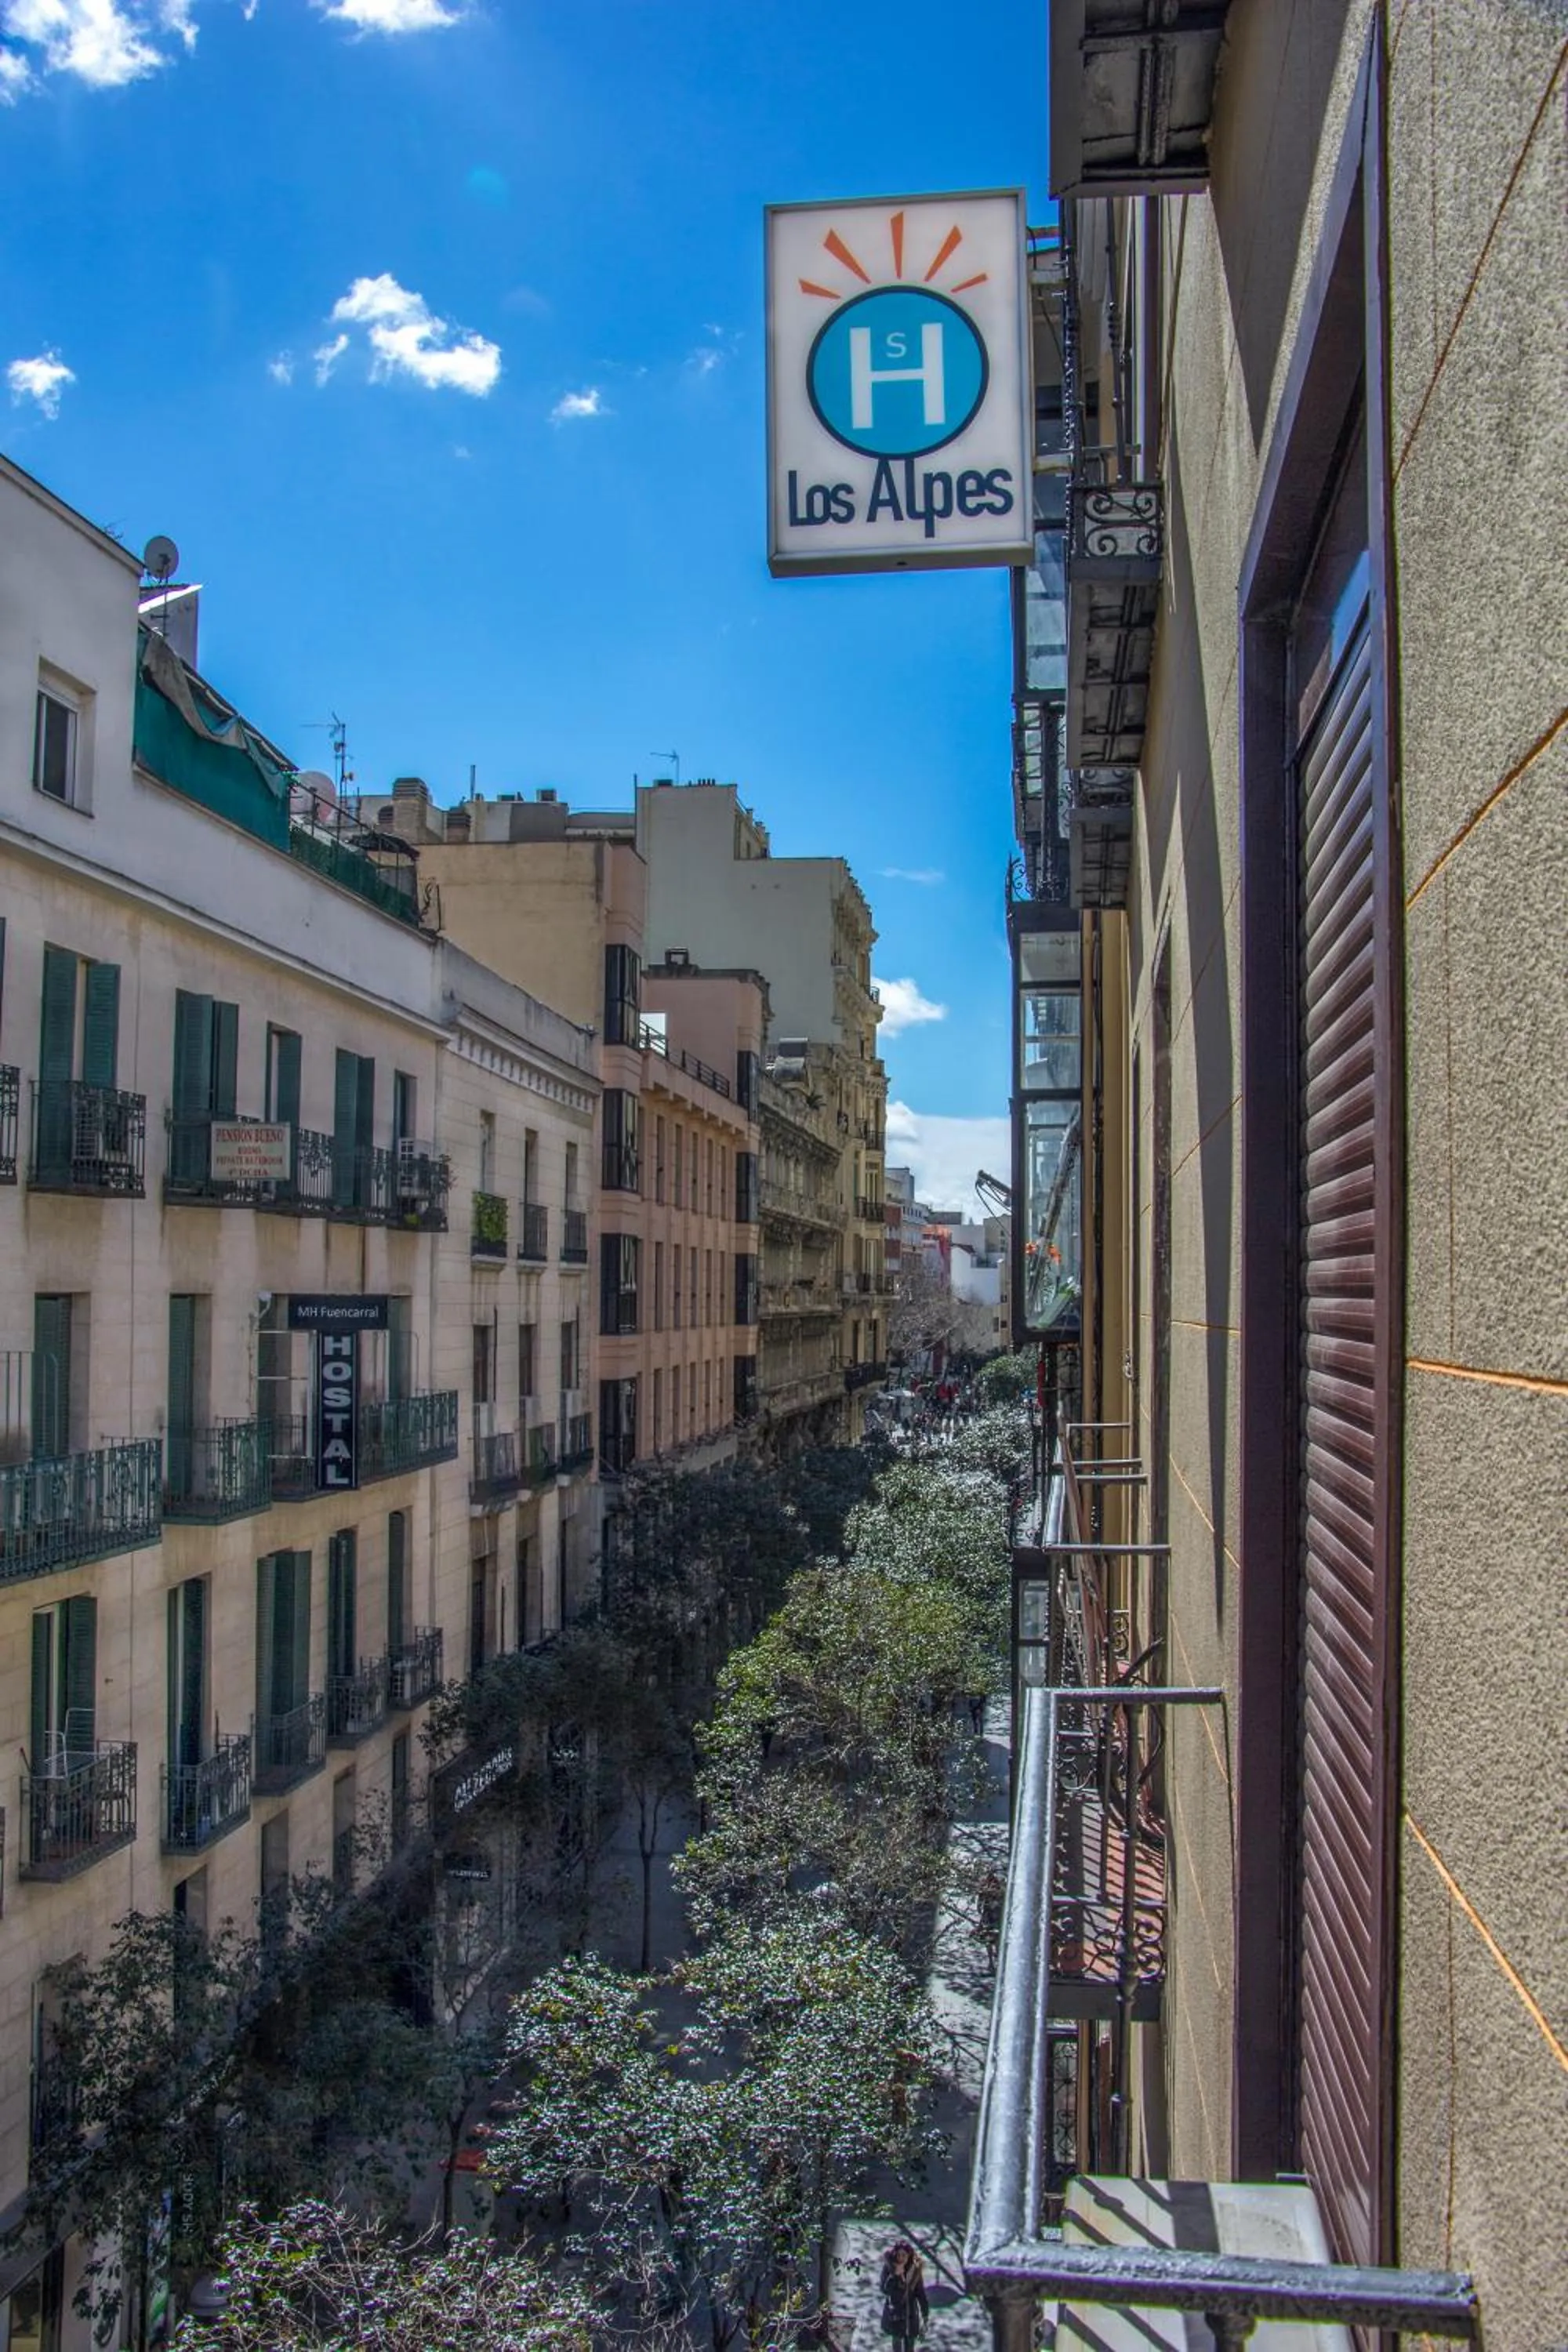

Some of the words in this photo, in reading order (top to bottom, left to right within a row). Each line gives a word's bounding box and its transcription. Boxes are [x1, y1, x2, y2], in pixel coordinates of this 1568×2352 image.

[788, 470, 855, 527] Los
[866, 458, 1014, 539] Alpes
[298, 1307, 318, 1317] MH
[321, 1306, 379, 1318] Fuencarral
[322, 1335, 352, 1484] HOSTAL
